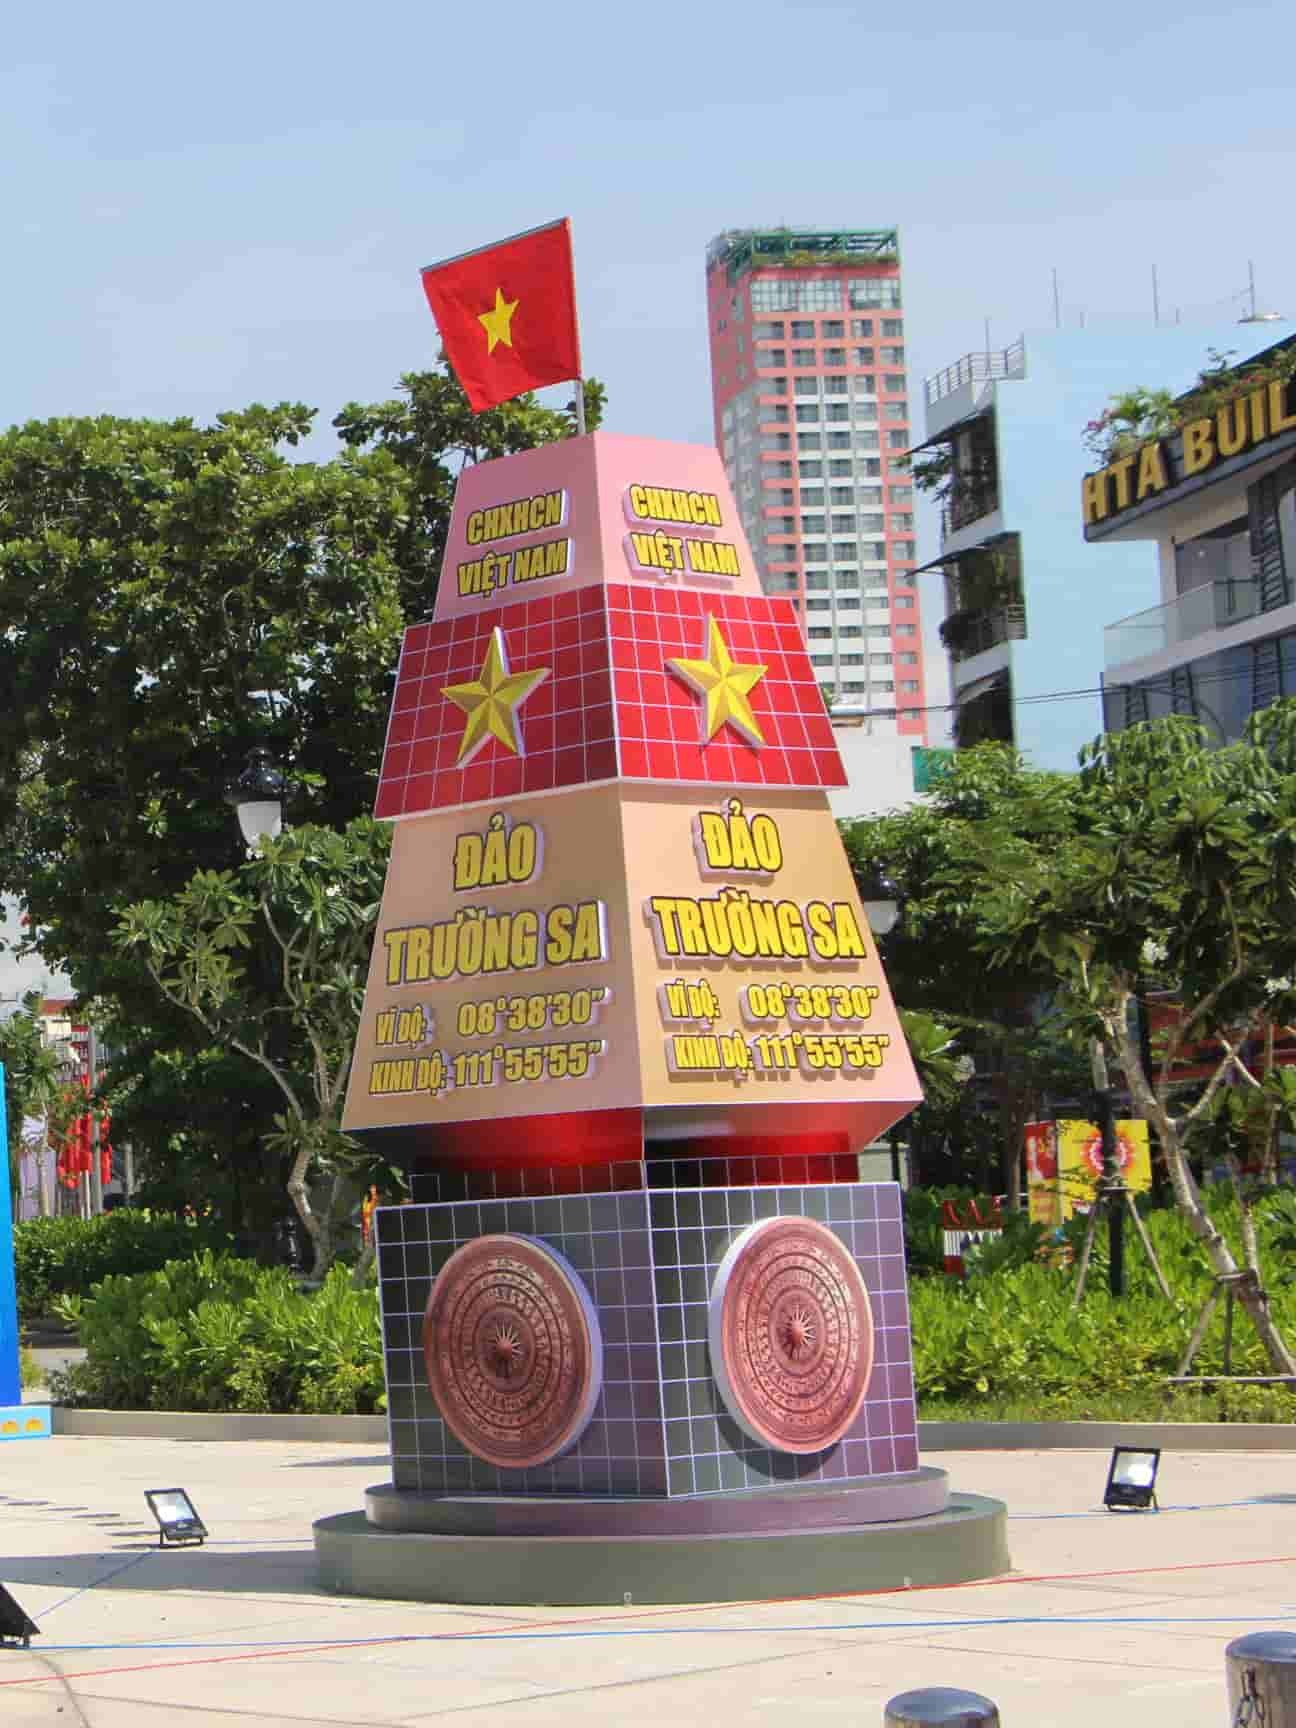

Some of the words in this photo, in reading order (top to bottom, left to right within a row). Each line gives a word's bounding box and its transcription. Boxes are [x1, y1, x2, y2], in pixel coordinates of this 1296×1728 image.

[1083, 441, 1169, 523] HTA
[1183, 379, 1296, 475] BUIL
[466, 489, 563, 546] CHXHCN
[629, 484, 722, 527] CHXHCN
[457, 551, 512, 598] VIỆT
[512, 538, 568, 584] NAM
[630, 527, 684, 575] VIỆT
[685, 539, 741, 577] NAM
[453, 811, 537, 892] ĐẢO
[699, 797, 783, 873] ĐẢO
[384, 905, 540, 986] TRƯỜNG
[545, 900, 602, 966] SA
[650, 886, 809, 959] TRƯỜNG
[806, 900, 867, 959] SA
[368, 1057, 416, 1095] KINH
[672, 1034, 721, 1069] KINH
